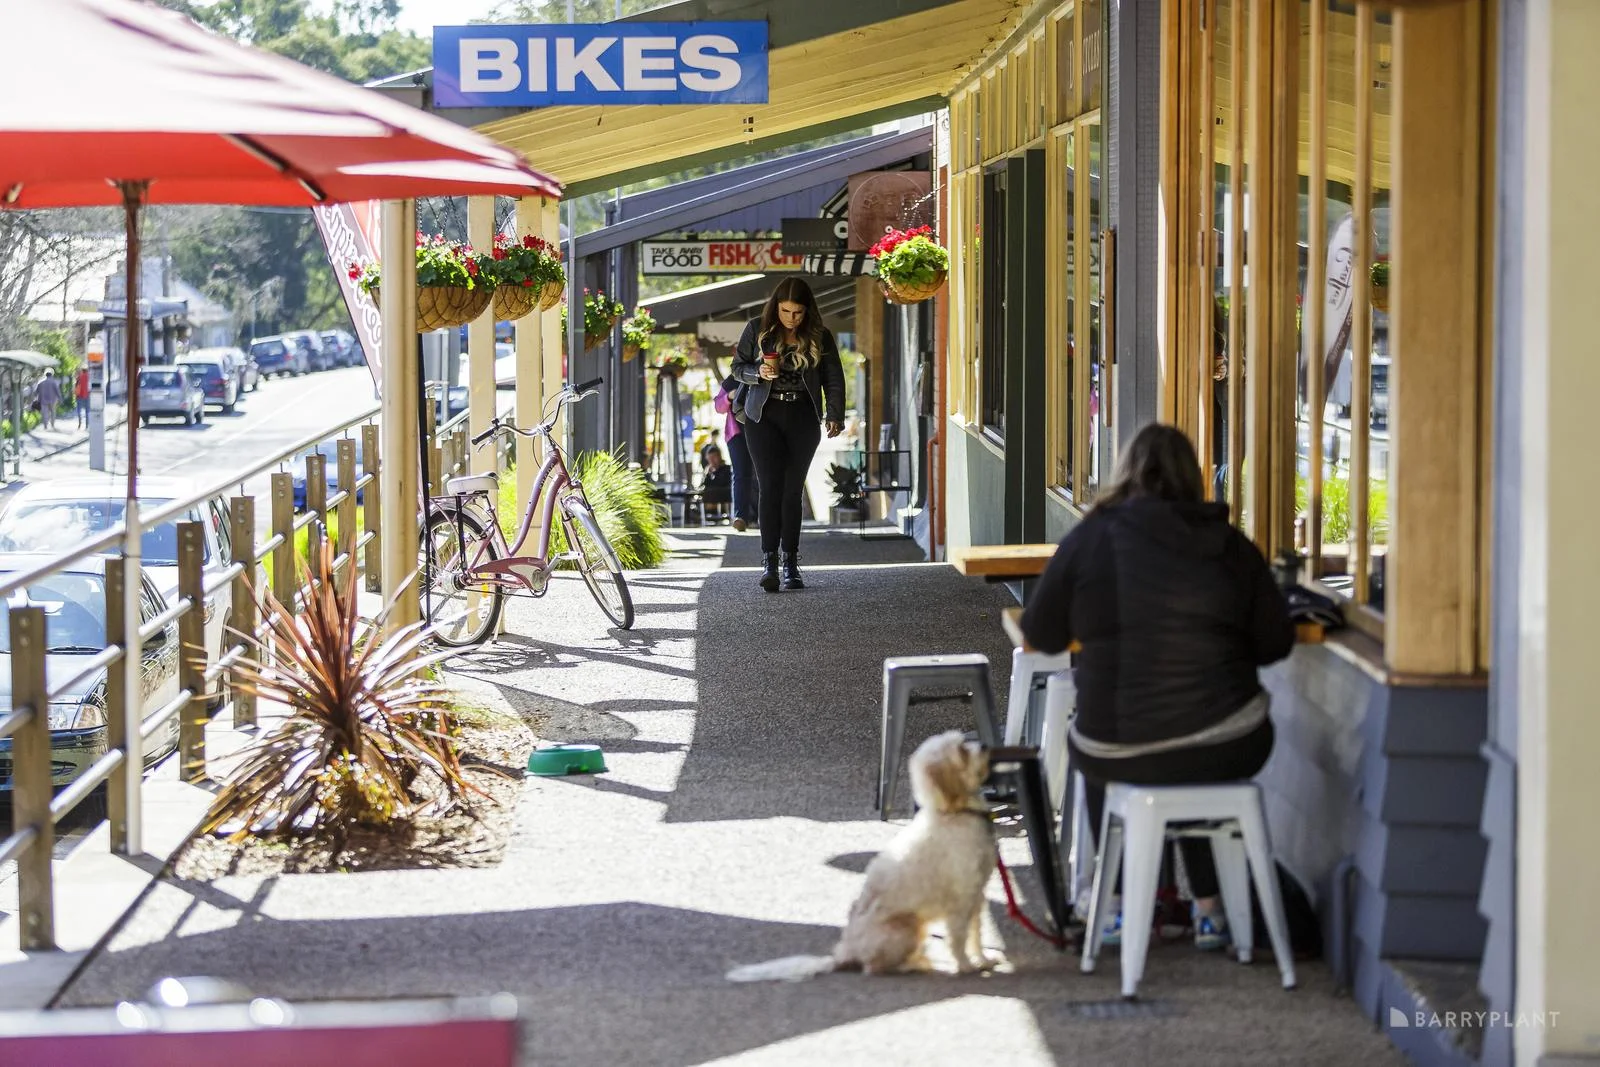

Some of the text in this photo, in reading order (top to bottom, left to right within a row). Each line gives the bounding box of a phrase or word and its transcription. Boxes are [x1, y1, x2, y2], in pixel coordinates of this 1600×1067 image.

[459, 35, 742, 93] BIKES
[651, 247, 675, 255] TAKE
[709, 243, 751, 265] FISH
[652, 254, 703, 267] FOOD
